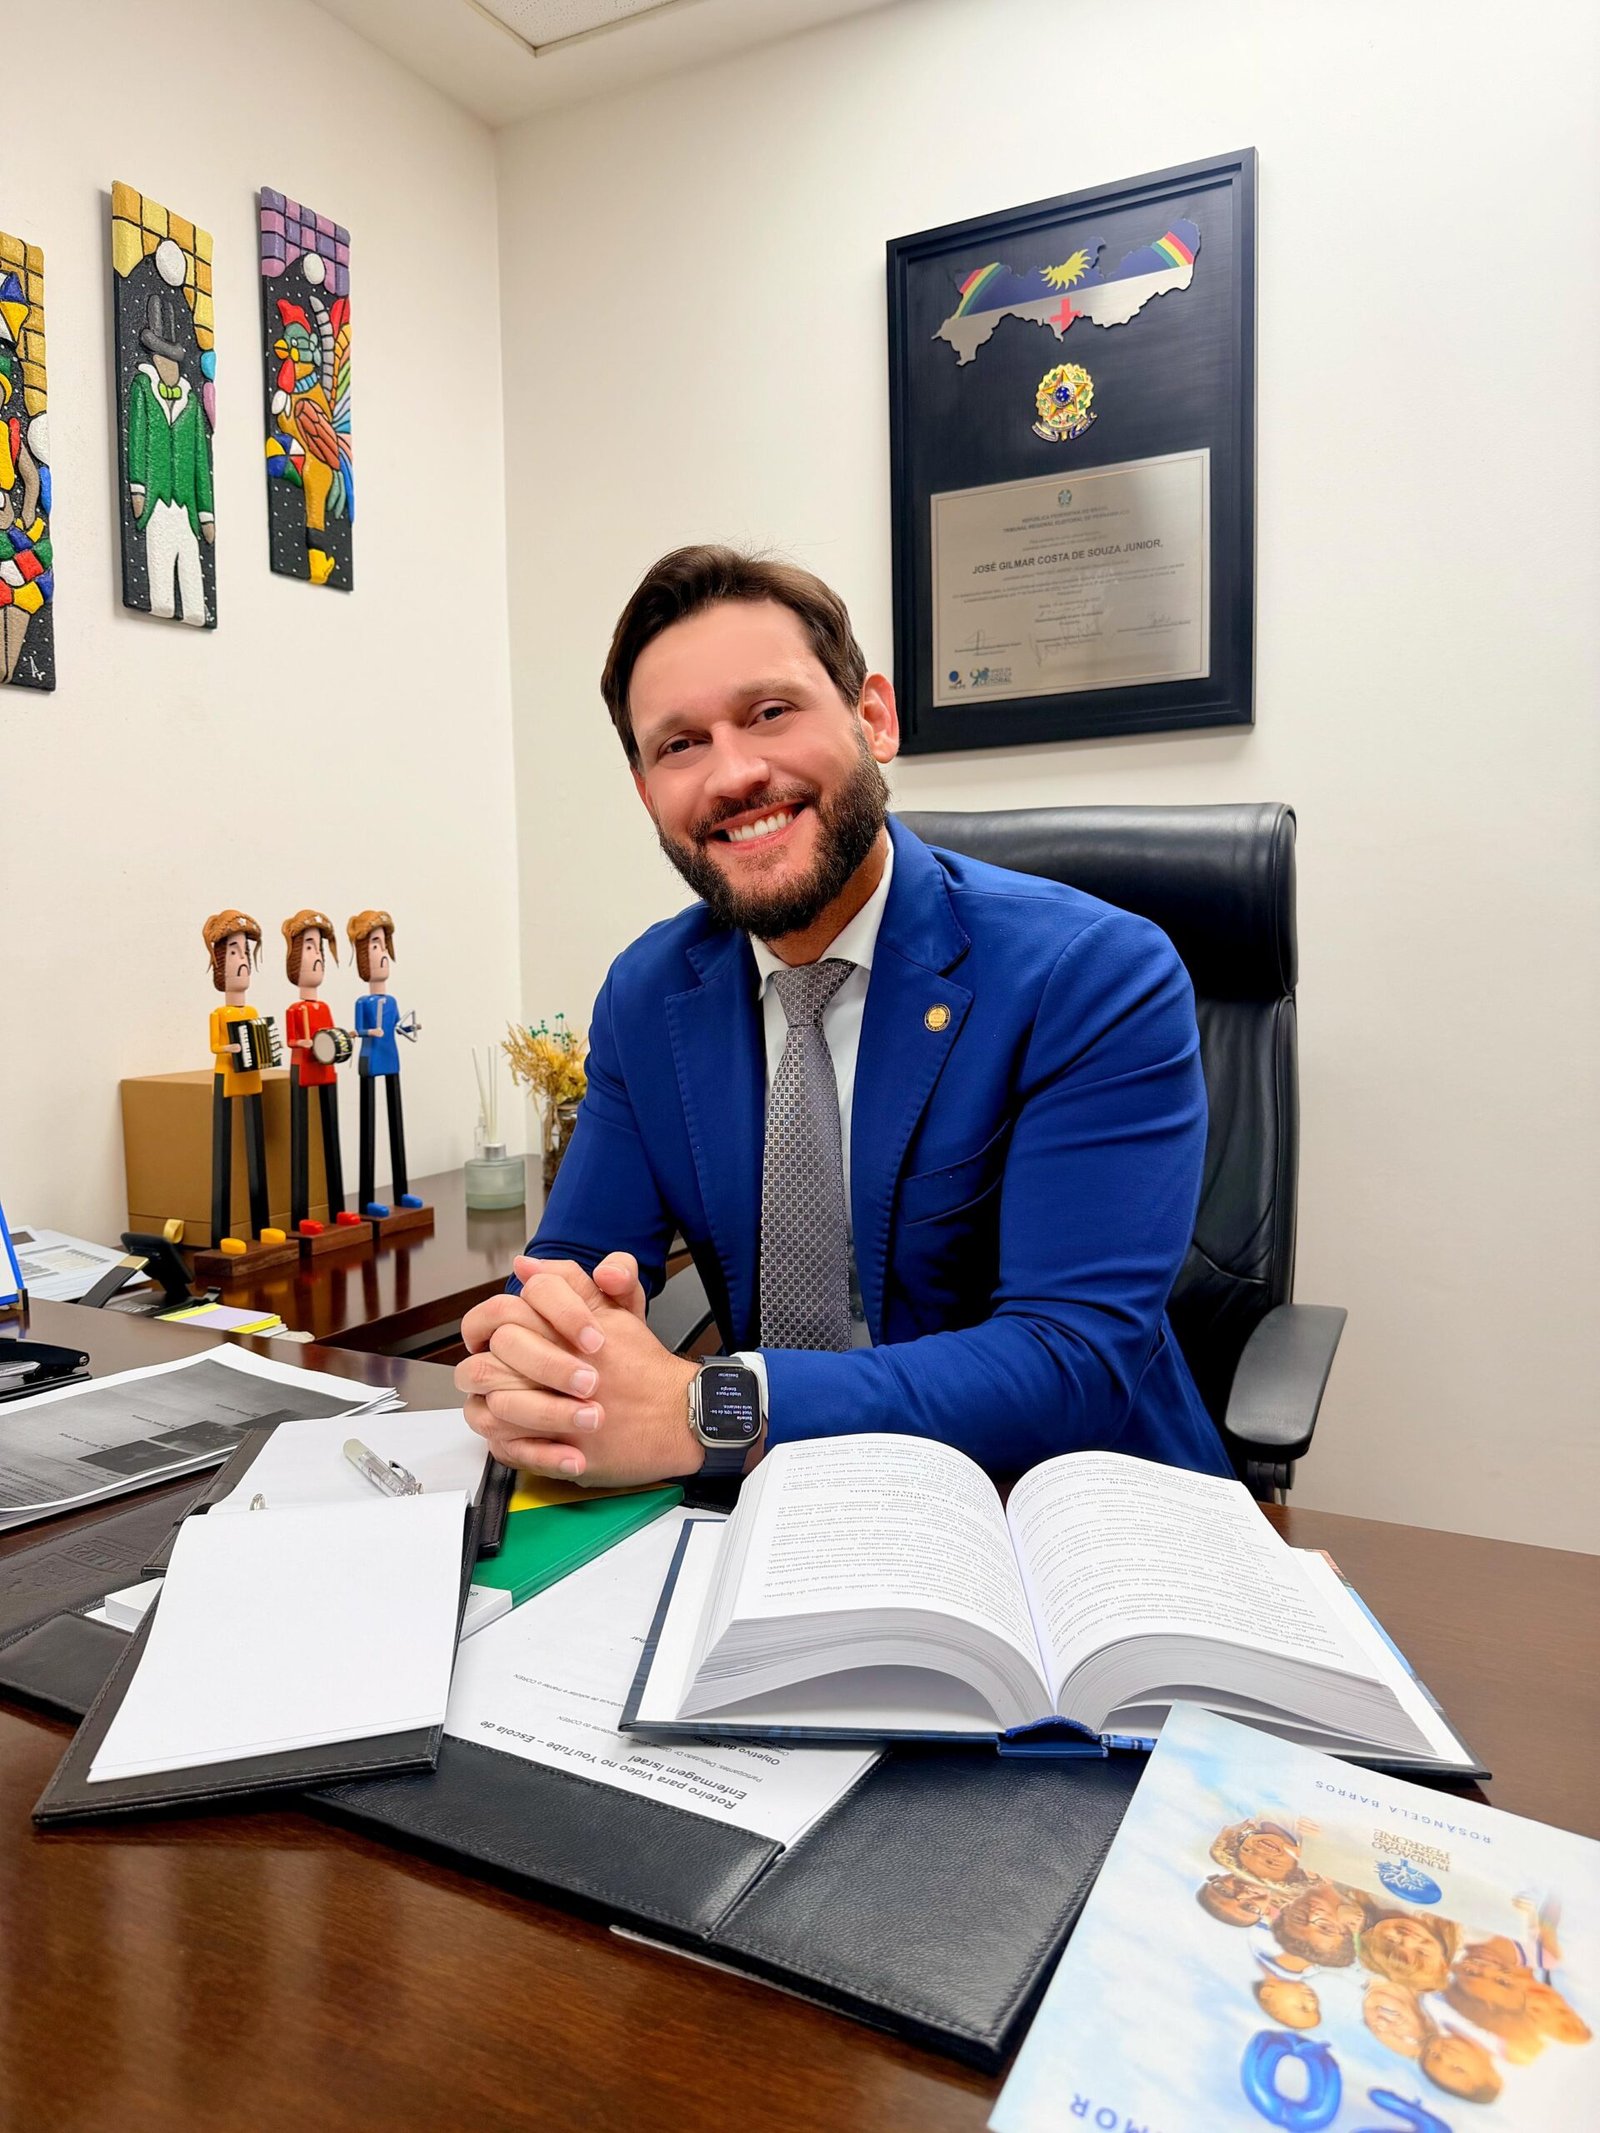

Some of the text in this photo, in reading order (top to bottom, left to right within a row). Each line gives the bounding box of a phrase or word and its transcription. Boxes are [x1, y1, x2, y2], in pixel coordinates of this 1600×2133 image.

[972, 562, 997, 575] JOSÉ
[998, 558, 1035, 571] GILMAR
[1037, 553, 1070, 566] COSTA
[1071, 550, 1085, 561] DE
[1087, 544, 1121, 558] SOUZA
[480, 1720, 496, 1731] de
[496, 1725, 536, 1743] Escola
[546, 1741, 597, 1764] YouTube
[738, 1747, 780, 1766] Objetivo
[600, 1759, 618, 1770] no
[619, 1763, 654, 1781] Vídeo
[627, 1755, 748, 1800] Enfermagem Israel
[656, 1776, 689, 1790] para
[688, 1785, 737, 1810] Roteiro
[1314, 1780, 1491, 1845] ROSÂNGELA BARROS
[1372, 1828, 1450, 1861] PERRONE
